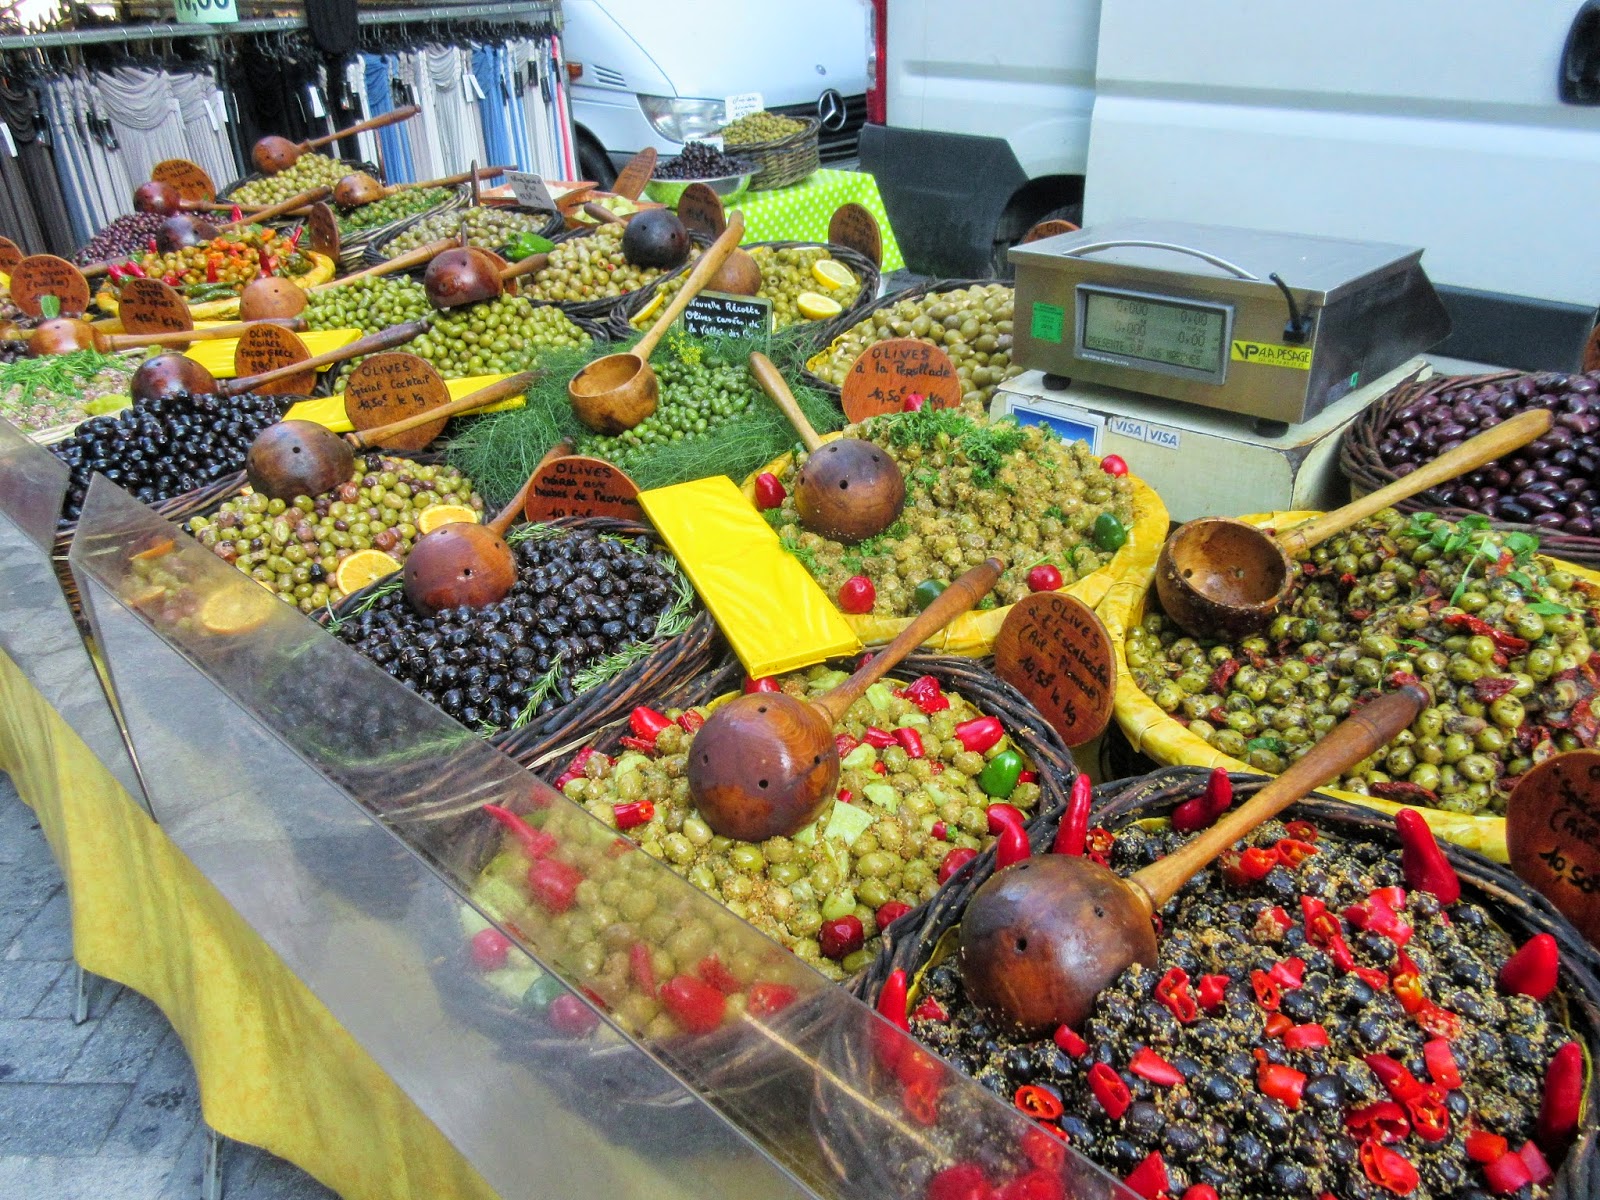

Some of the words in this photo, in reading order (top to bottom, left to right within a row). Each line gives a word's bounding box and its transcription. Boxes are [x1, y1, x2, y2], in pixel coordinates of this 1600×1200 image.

[688, 298, 722, 311] Nouvelle
[725, 301, 760, 315] Récolte
[685, 310, 712, 322] Olives
[749, 319, 760, 329] de
[688, 322, 697, 333] la
[872, 347, 930, 360] OLIVES
[361, 360, 412, 377] OLIVES
[876, 361, 888, 374] la
[390, 373, 431, 390] Cocktail
[397, 394, 408, 406] le
[412, 391, 426, 409] Kg
[1114, 420, 1143, 437] VISA
[1149, 430, 1178, 447] VISA
[555, 462, 613, 479] OLIVES
[583, 480, 607, 489] aux
[573, 490, 587, 501] de
[1051, 598, 1100, 649] OLIVES
